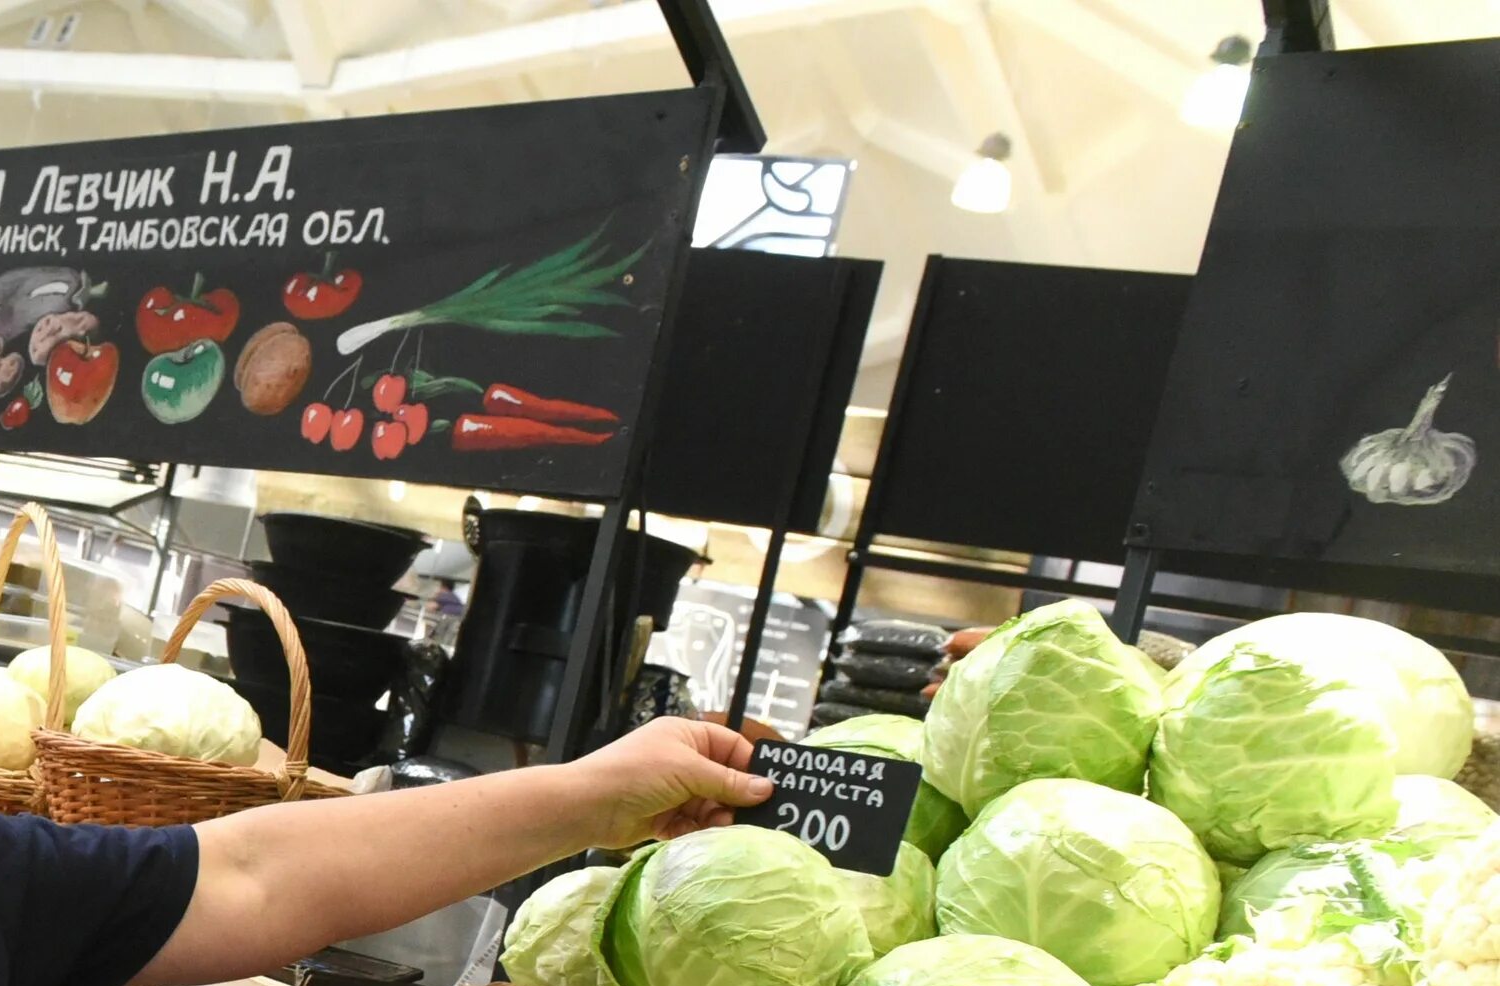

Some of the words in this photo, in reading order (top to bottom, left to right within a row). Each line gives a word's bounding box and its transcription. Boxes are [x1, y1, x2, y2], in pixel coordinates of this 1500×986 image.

[20, 165, 176, 217] ЛЕВЧИК
[75, 212, 290, 253] ТАМБОВСКАЯ
[302, 207, 391, 247] ОБЛ.
[759, 743, 886, 781] МОЛОДАЯ
[766, 767, 885, 808] КАПУСТА
[776, 802, 851, 852] 200
